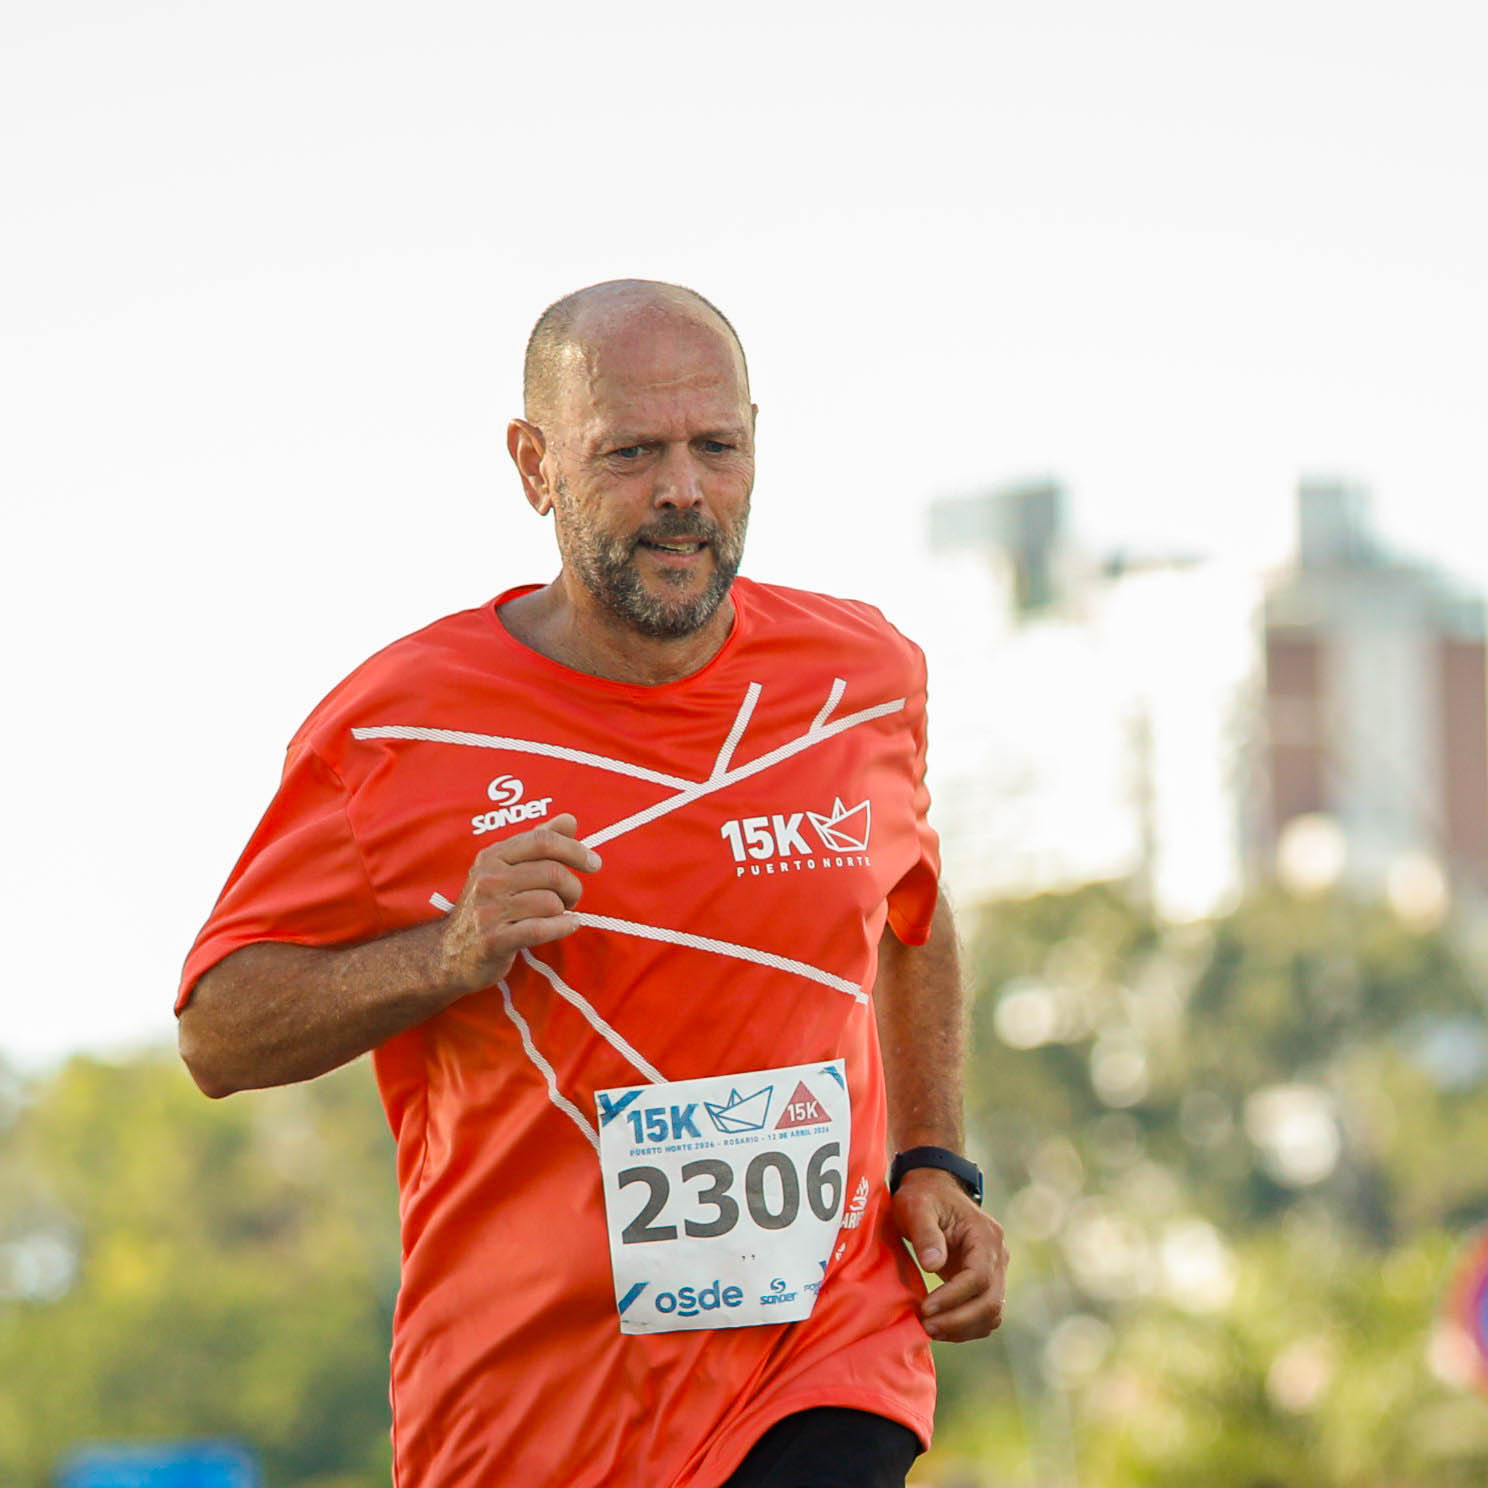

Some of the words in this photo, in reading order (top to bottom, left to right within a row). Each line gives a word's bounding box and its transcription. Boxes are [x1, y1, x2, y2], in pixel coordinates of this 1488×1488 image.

[721, 812, 813, 862] 15K
[736, 859, 815, 877] PUERTO
[822, 856, 872, 868] NORTE
[627, 1103, 702, 1144] 15K
[786, 1100, 819, 1122] 15K
[629, 1147, 662, 1156] PUERTO
[665, 1143, 692, 1152] NORTE
[723, 1137, 759, 1146] ROSARIO
[791, 1129, 811, 1137] ABRIL
[617, 1142, 842, 1245] 2306
[655, 1279, 744, 1316] osde
